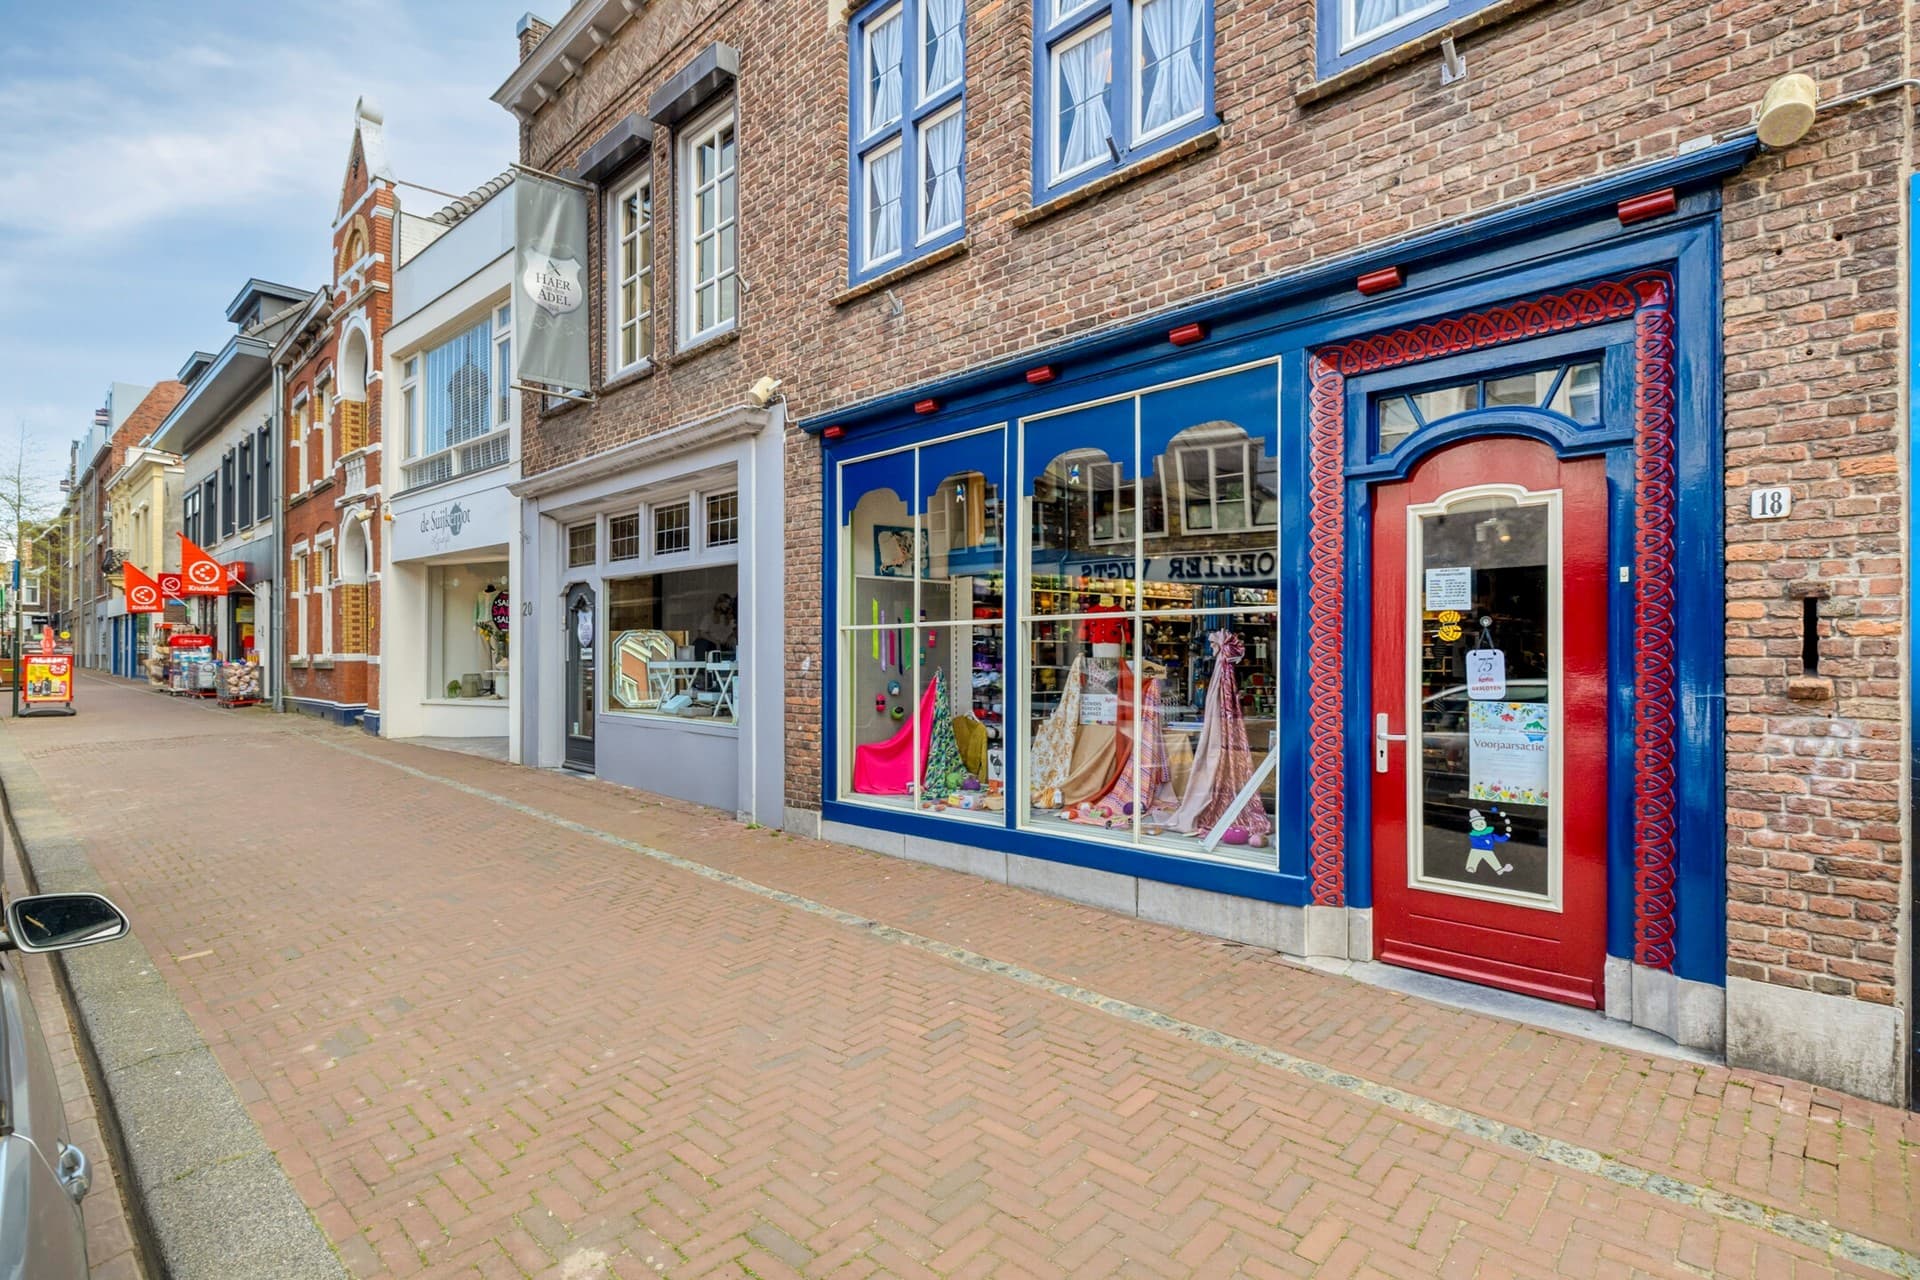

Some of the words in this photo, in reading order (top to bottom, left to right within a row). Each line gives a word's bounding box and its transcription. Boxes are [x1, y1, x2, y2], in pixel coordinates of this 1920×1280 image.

[536, 272, 571, 291] HAER
[538, 289, 571, 306] ADEL
[1759, 491, 1782, 516] 18
[420, 512, 429, 533] de
[522, 602, 533, 617] 20
[1473, 738, 1545, 752] Voorjaarsactie
